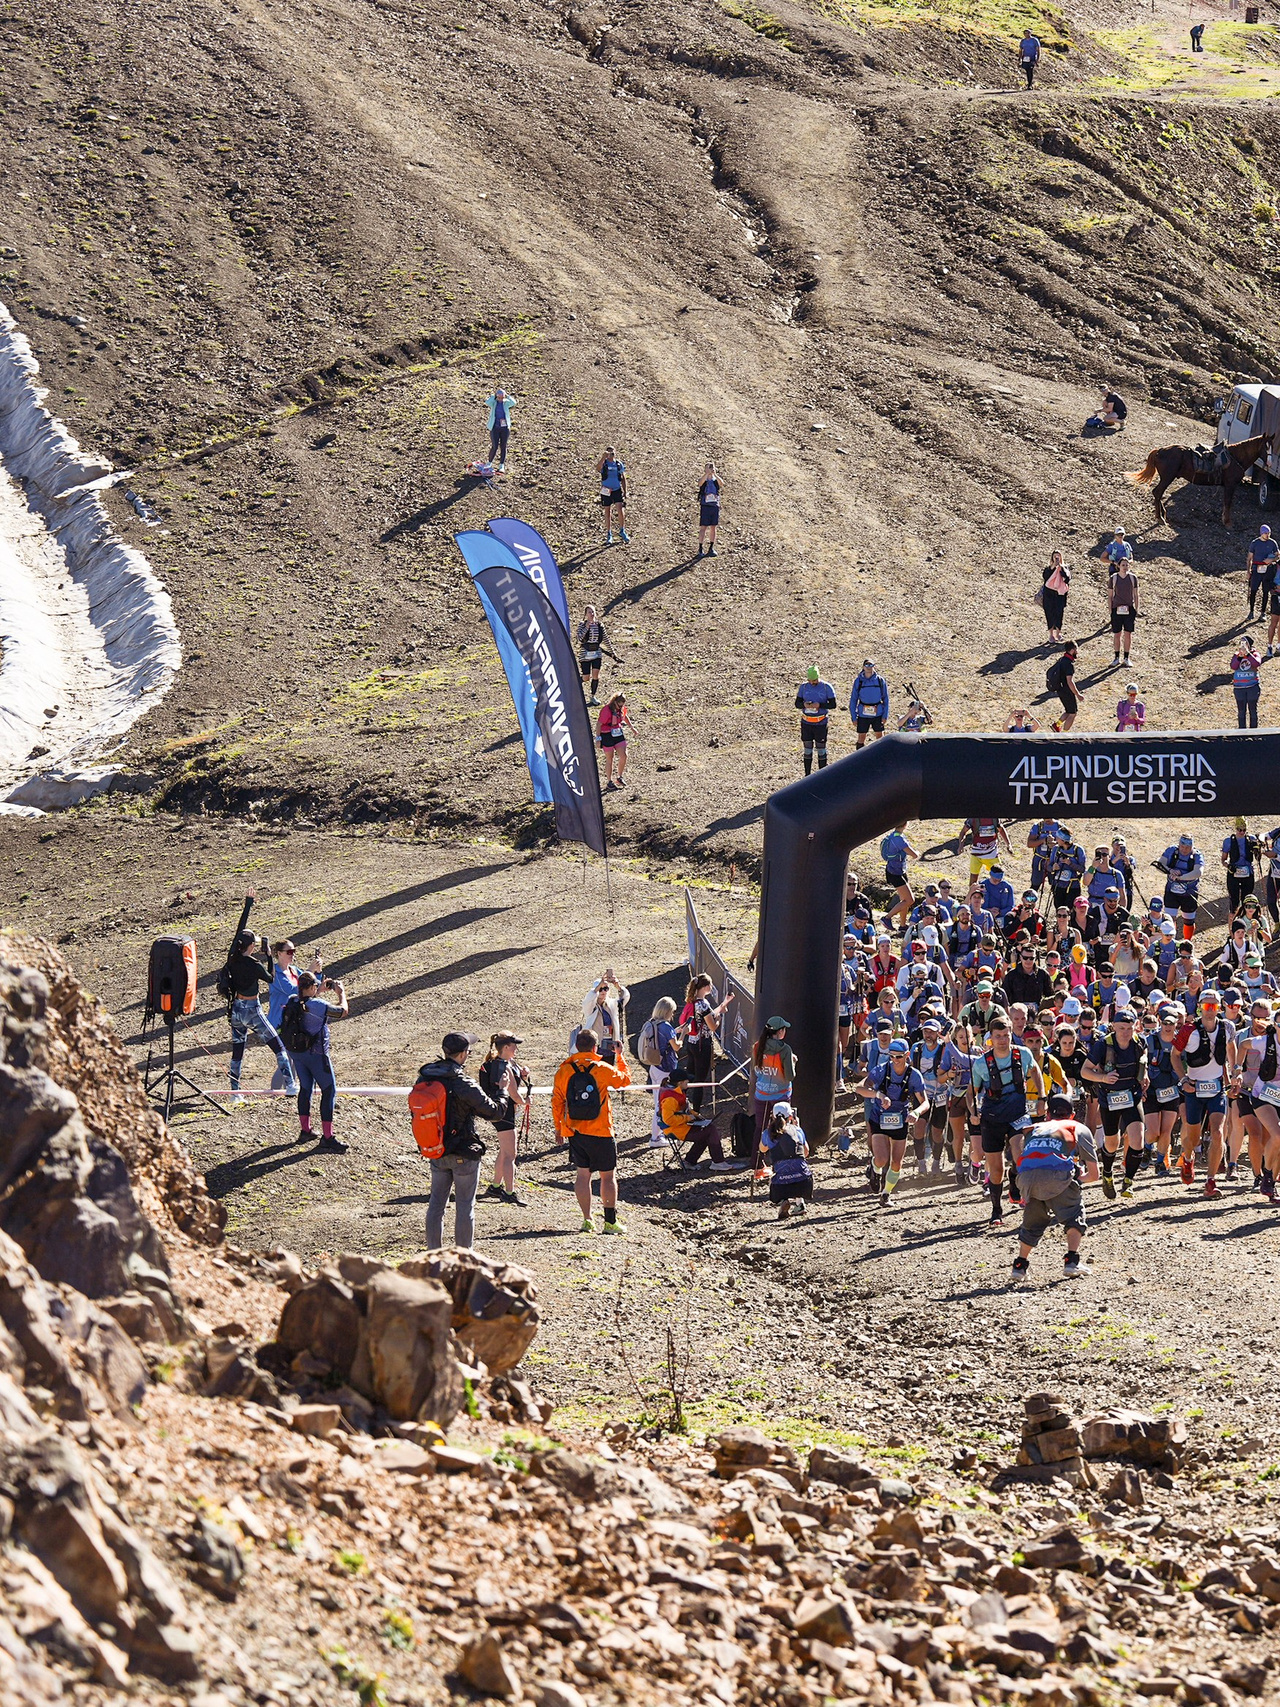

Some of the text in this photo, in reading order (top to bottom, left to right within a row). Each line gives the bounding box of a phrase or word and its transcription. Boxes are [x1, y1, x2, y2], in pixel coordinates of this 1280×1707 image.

[1008, 753, 1216, 780] ALPINDUSTRIA
[1009, 780, 1217, 805] TRAIL SERIES
[1024, 1140, 1062, 1152] TEAM
